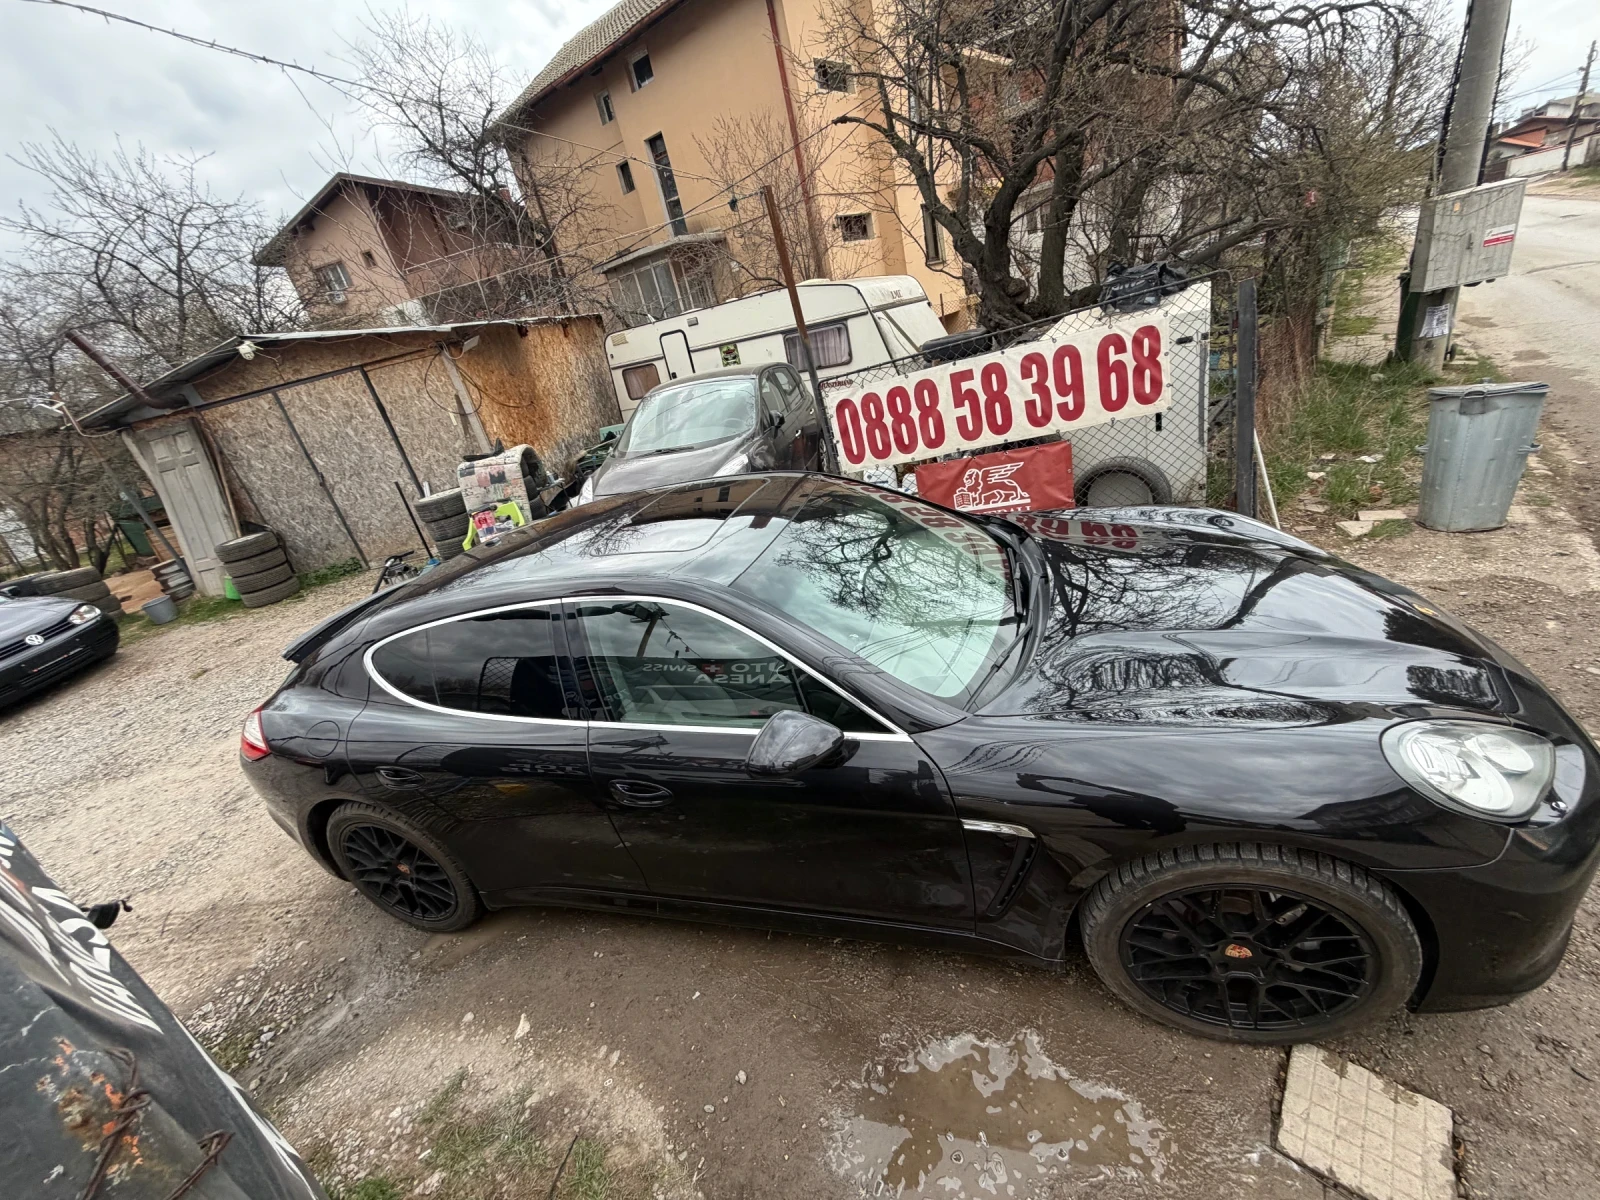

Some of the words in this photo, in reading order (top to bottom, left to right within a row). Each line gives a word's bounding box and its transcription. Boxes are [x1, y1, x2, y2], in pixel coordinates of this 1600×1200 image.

[835, 379, 946, 465] 0888
[949, 362, 1013, 441] 58
[1020, 345, 1085, 428] 39
[1097, 325, 1163, 412] 68
